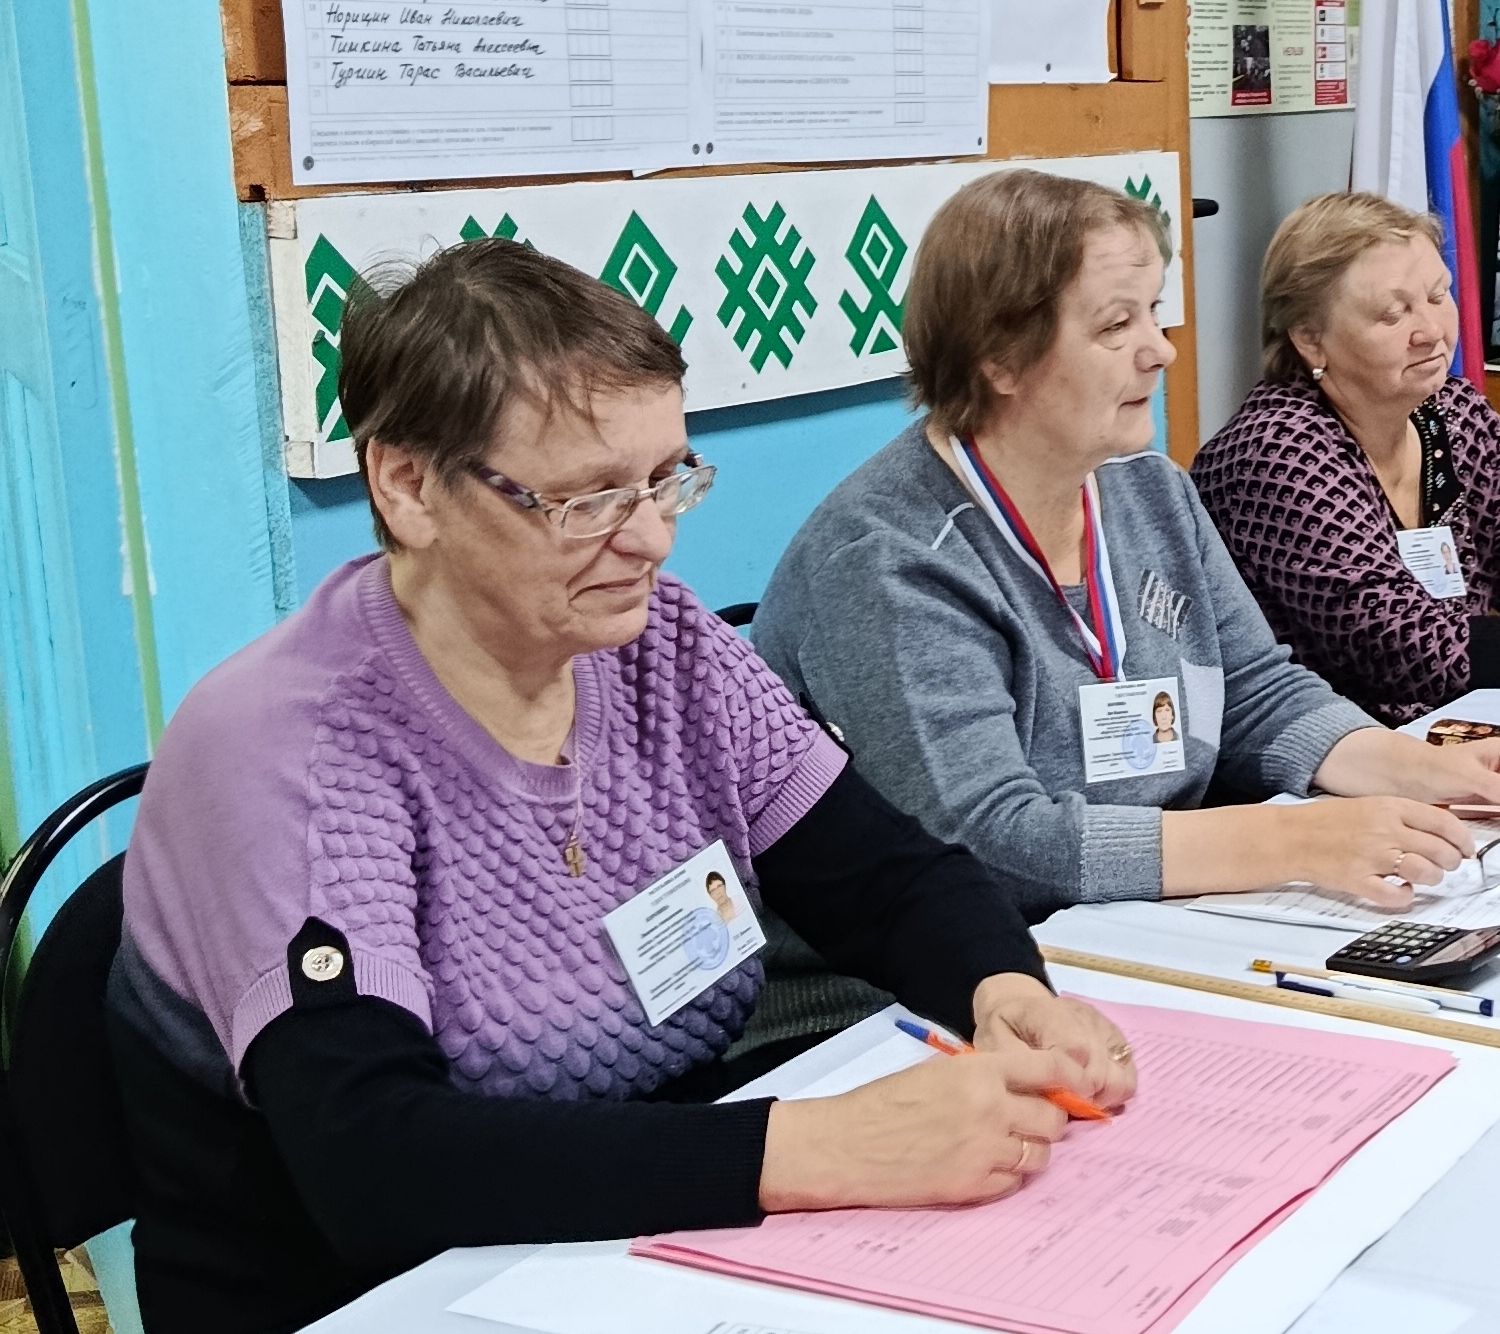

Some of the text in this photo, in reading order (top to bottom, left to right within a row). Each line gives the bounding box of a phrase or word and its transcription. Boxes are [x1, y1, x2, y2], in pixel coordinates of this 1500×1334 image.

[399, 7, 433, 25] Иван
[440, 10, 525, 28] Николаевич
[331, 34, 547, 55] Тимкина Татьяна Алексеевна
[399, 63, 441, 87] Тарас
[454, 61, 535, 79] Васильевич
